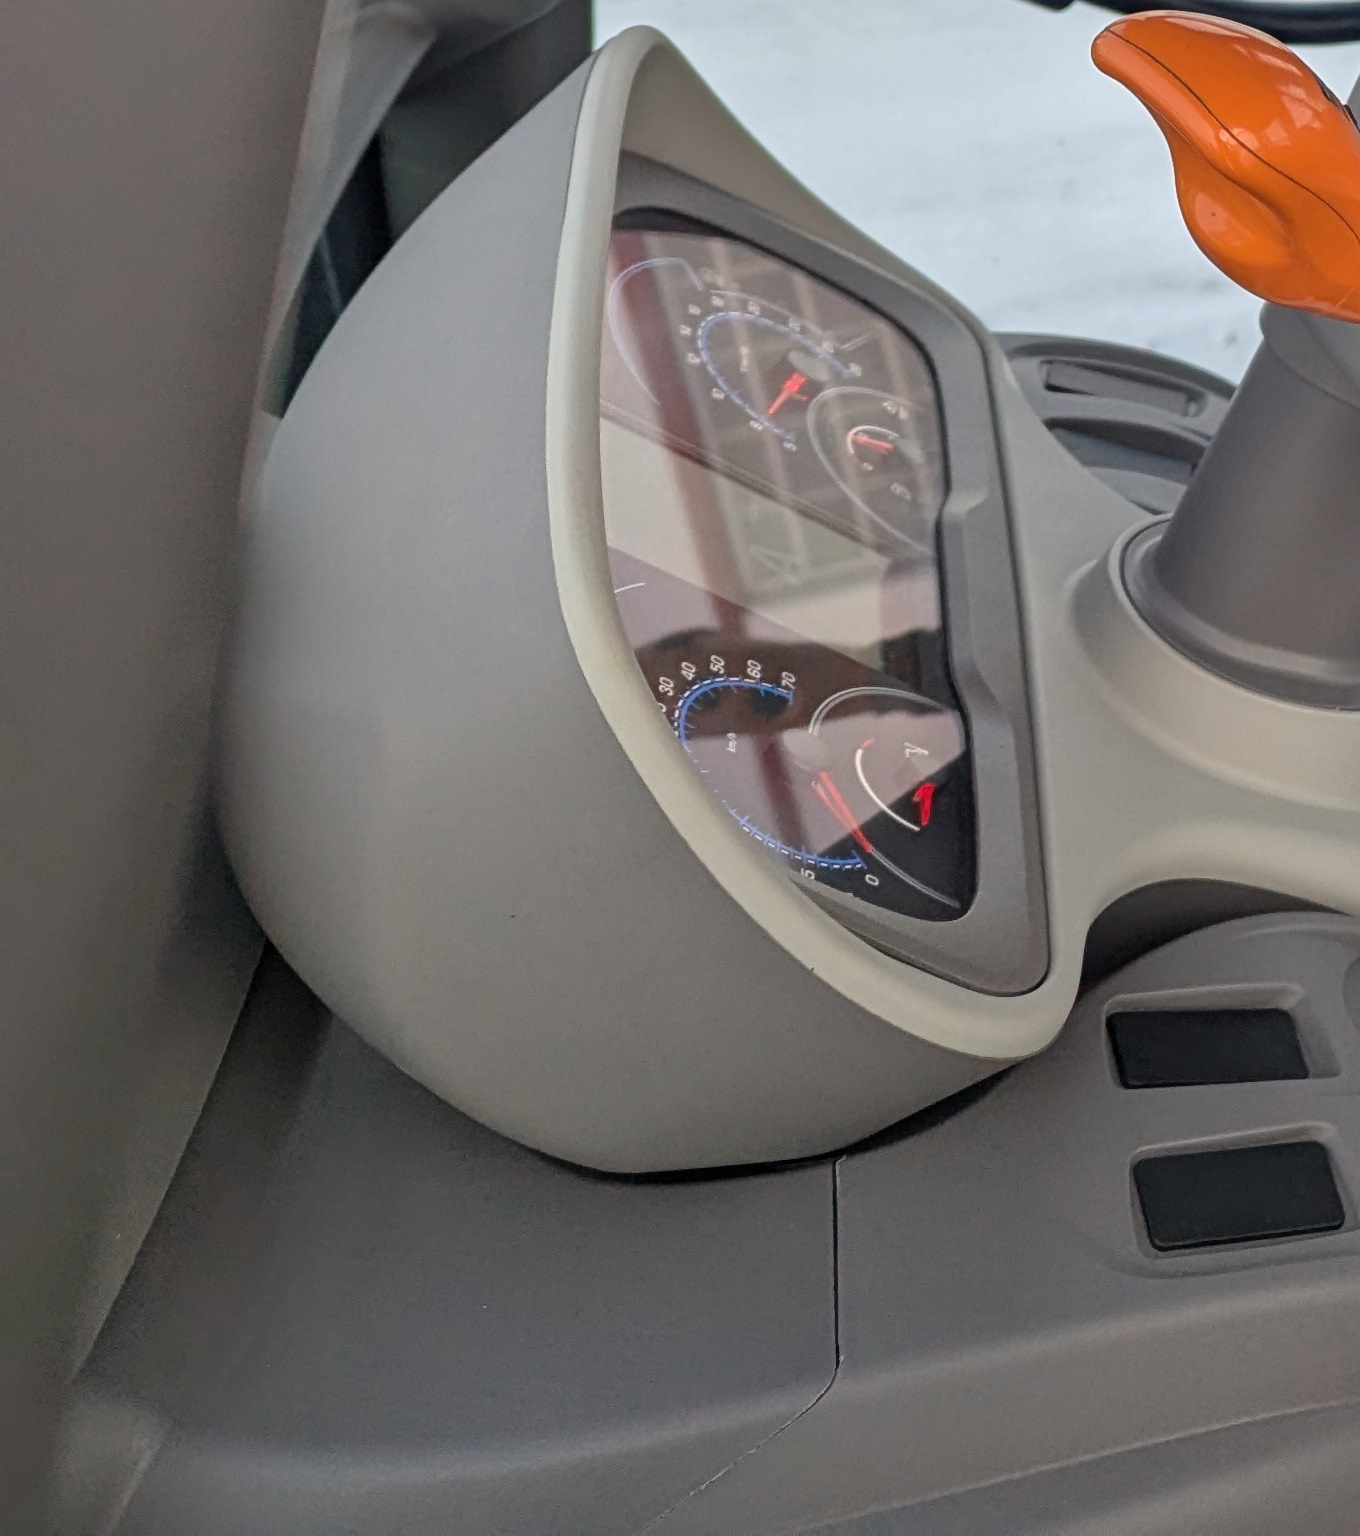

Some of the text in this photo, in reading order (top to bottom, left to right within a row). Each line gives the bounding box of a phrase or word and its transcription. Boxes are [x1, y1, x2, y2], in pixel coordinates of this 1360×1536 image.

[681, 662, 696, 681] 40
[710, 655, 725, 674] 50
[747, 660, 761, 679] 60
[658, 677, 674, 696] 30
[781, 672, 796, 690] 70
[864, 874, 880, 886] 0
